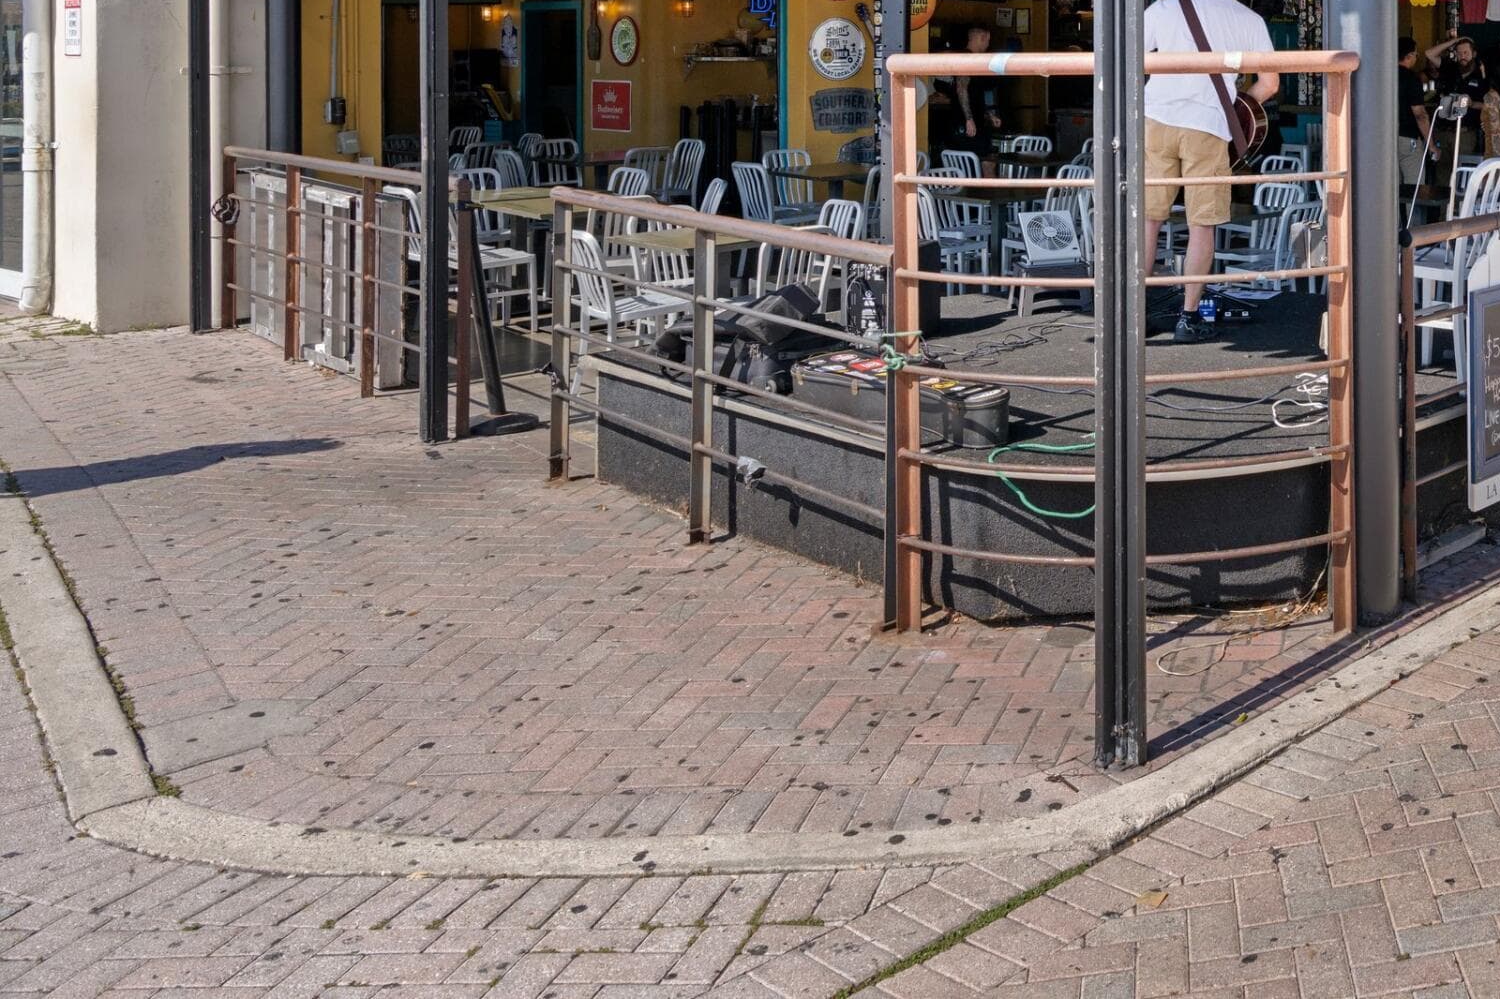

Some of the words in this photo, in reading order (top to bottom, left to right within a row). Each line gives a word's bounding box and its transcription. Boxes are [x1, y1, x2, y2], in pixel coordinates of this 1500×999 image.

[911, 6, 928, 16] ight
[818, 111, 869, 127] COMFORT
[1486, 484, 1498, 500] LA
